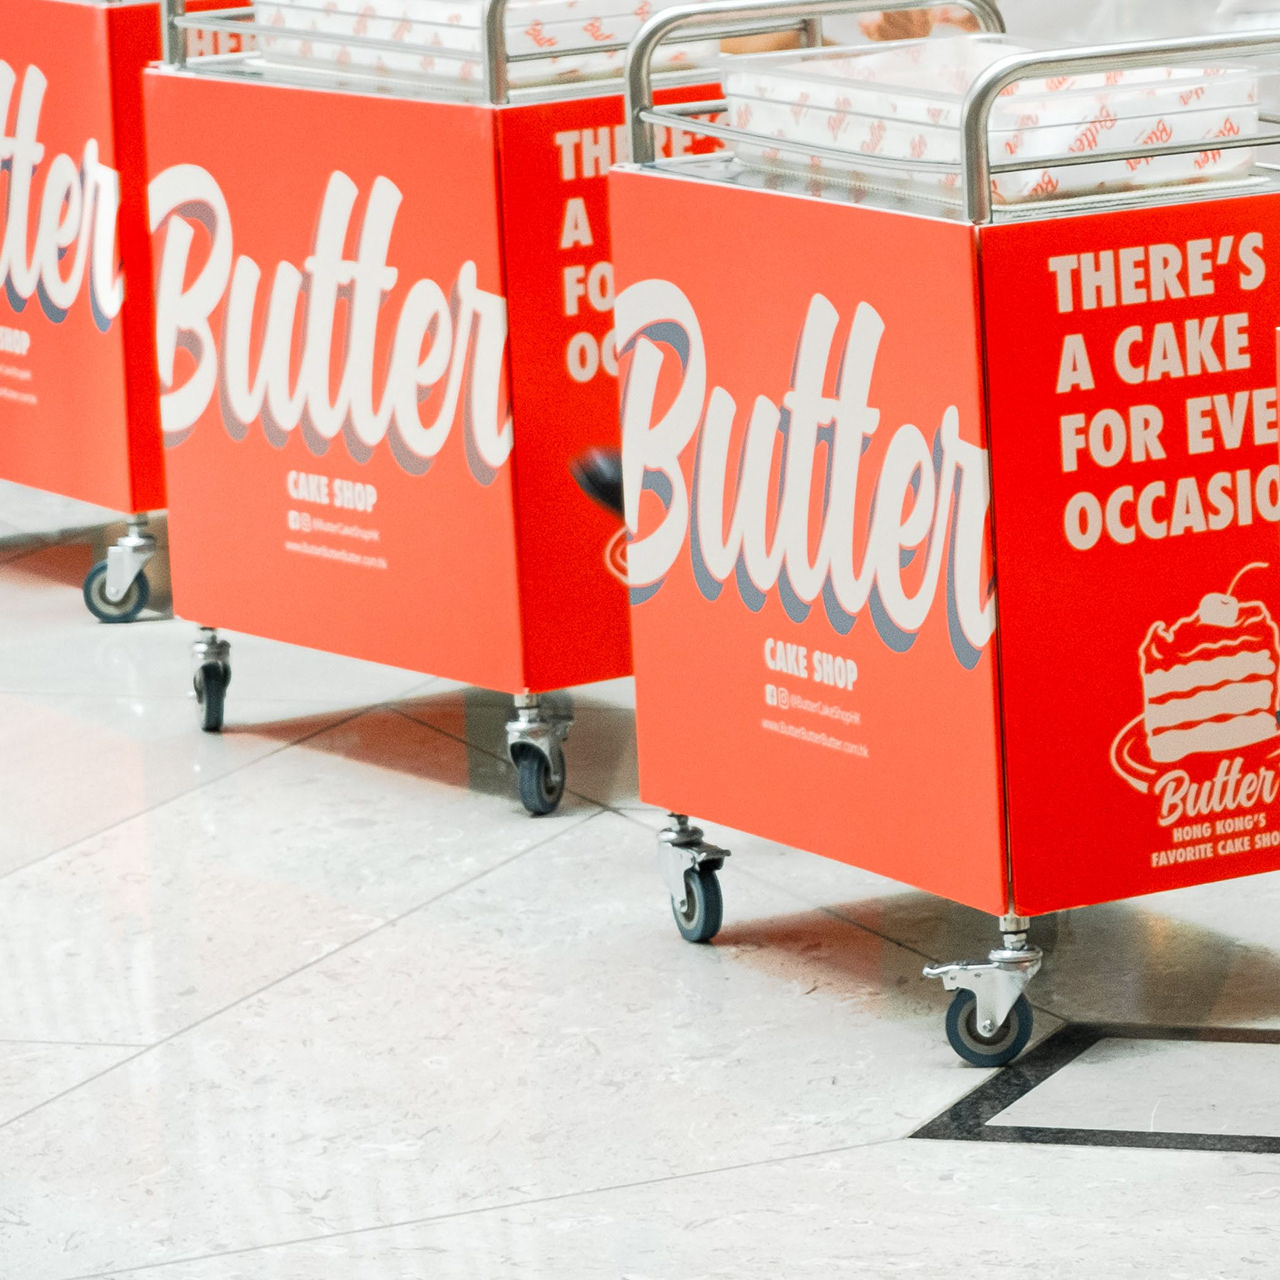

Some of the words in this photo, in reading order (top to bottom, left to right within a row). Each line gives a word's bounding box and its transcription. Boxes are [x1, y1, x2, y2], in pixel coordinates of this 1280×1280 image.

[0, 59, 125, 322] tter
[560, 197, 593, 250] A
[563, 261, 615, 317] FO
[1049, 230, 1267, 314] THERE'S
[147, 163, 515, 482] Butter
[1057, 332, 1095, 394] A
[1113, 315, 1253, 382] CAKE
[614, 278, 998, 655] Butter
[1061, 406, 1165, 472] FOR
[1186, 390, 1278, 454] EVE
[287, 469, 330, 506] CAKE
[333, 478, 378, 513] SHOP
[764, 637, 809, 679] CAKE
[812, 650, 859, 692] SHOP
[1153, 756, 1280, 827] Butter
[1151, 842, 1214, 868] FAVORITE
[1217, 836, 1251, 855] CAKE
[1172, 822, 1212, 843] HONG
[1215, 812, 1267, 835] KONG'S
